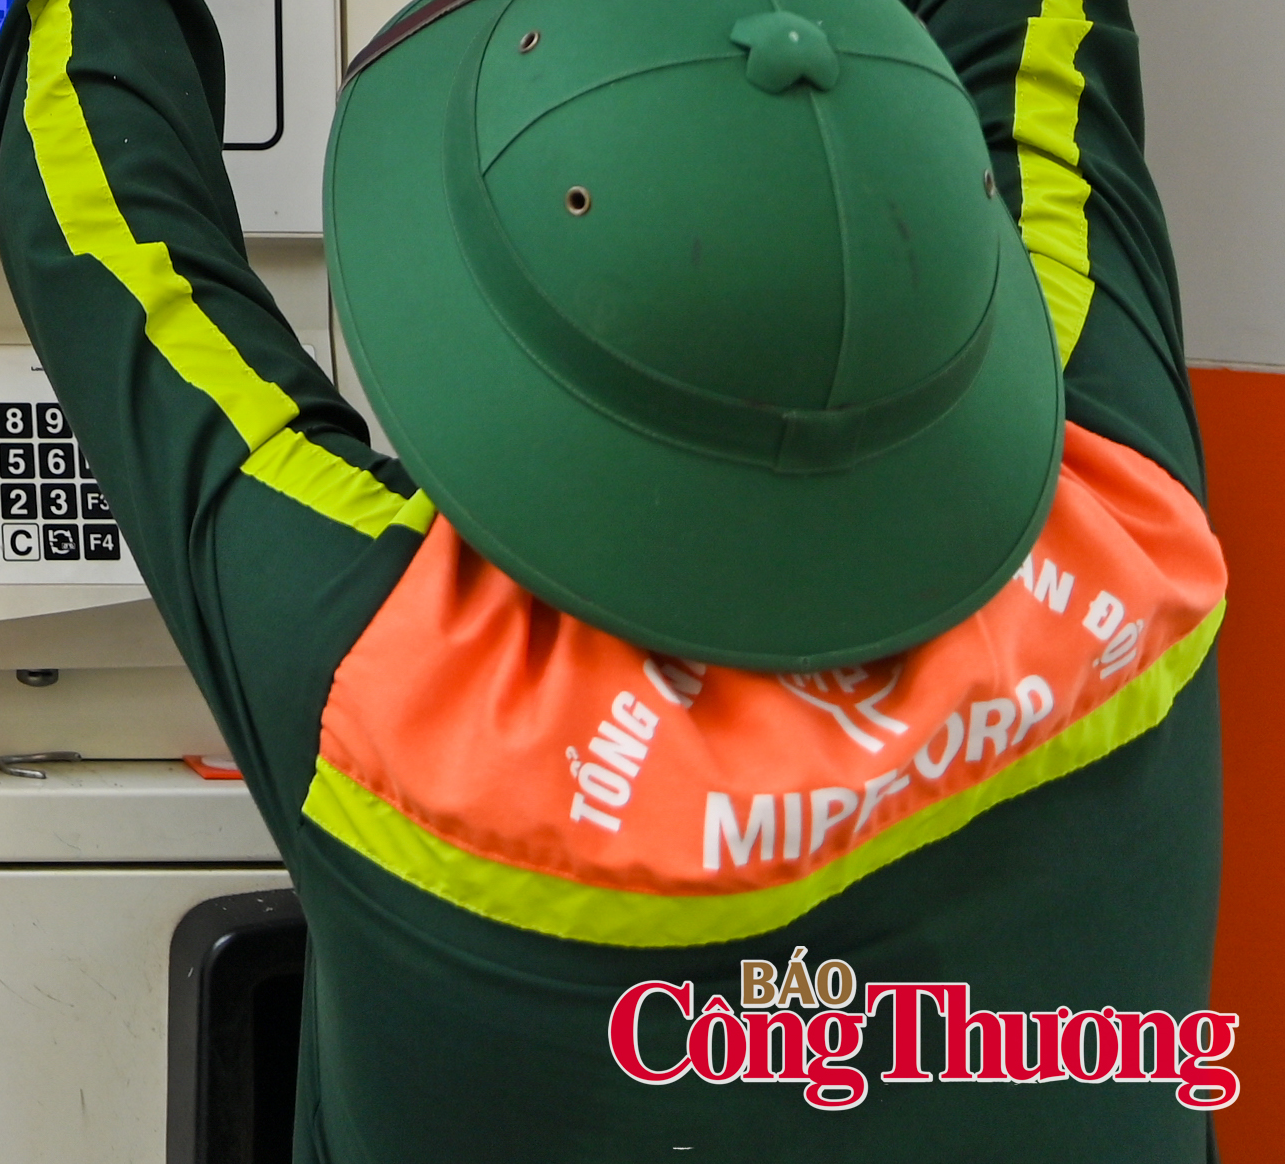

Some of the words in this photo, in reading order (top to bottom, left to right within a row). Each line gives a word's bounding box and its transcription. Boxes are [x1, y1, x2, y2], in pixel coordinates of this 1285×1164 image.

[6, 407, 24, 434] 8
[45, 407, 64, 434] 9
[8, 449, 26, 475] 5
[47, 448, 66, 475] 6
[9, 489, 28, 515] 2
[49, 489, 68, 516] 3
[10, 529, 33, 556] C
[89, 534, 114, 551] F4
[565, 690, 660, 833] TỔNG
